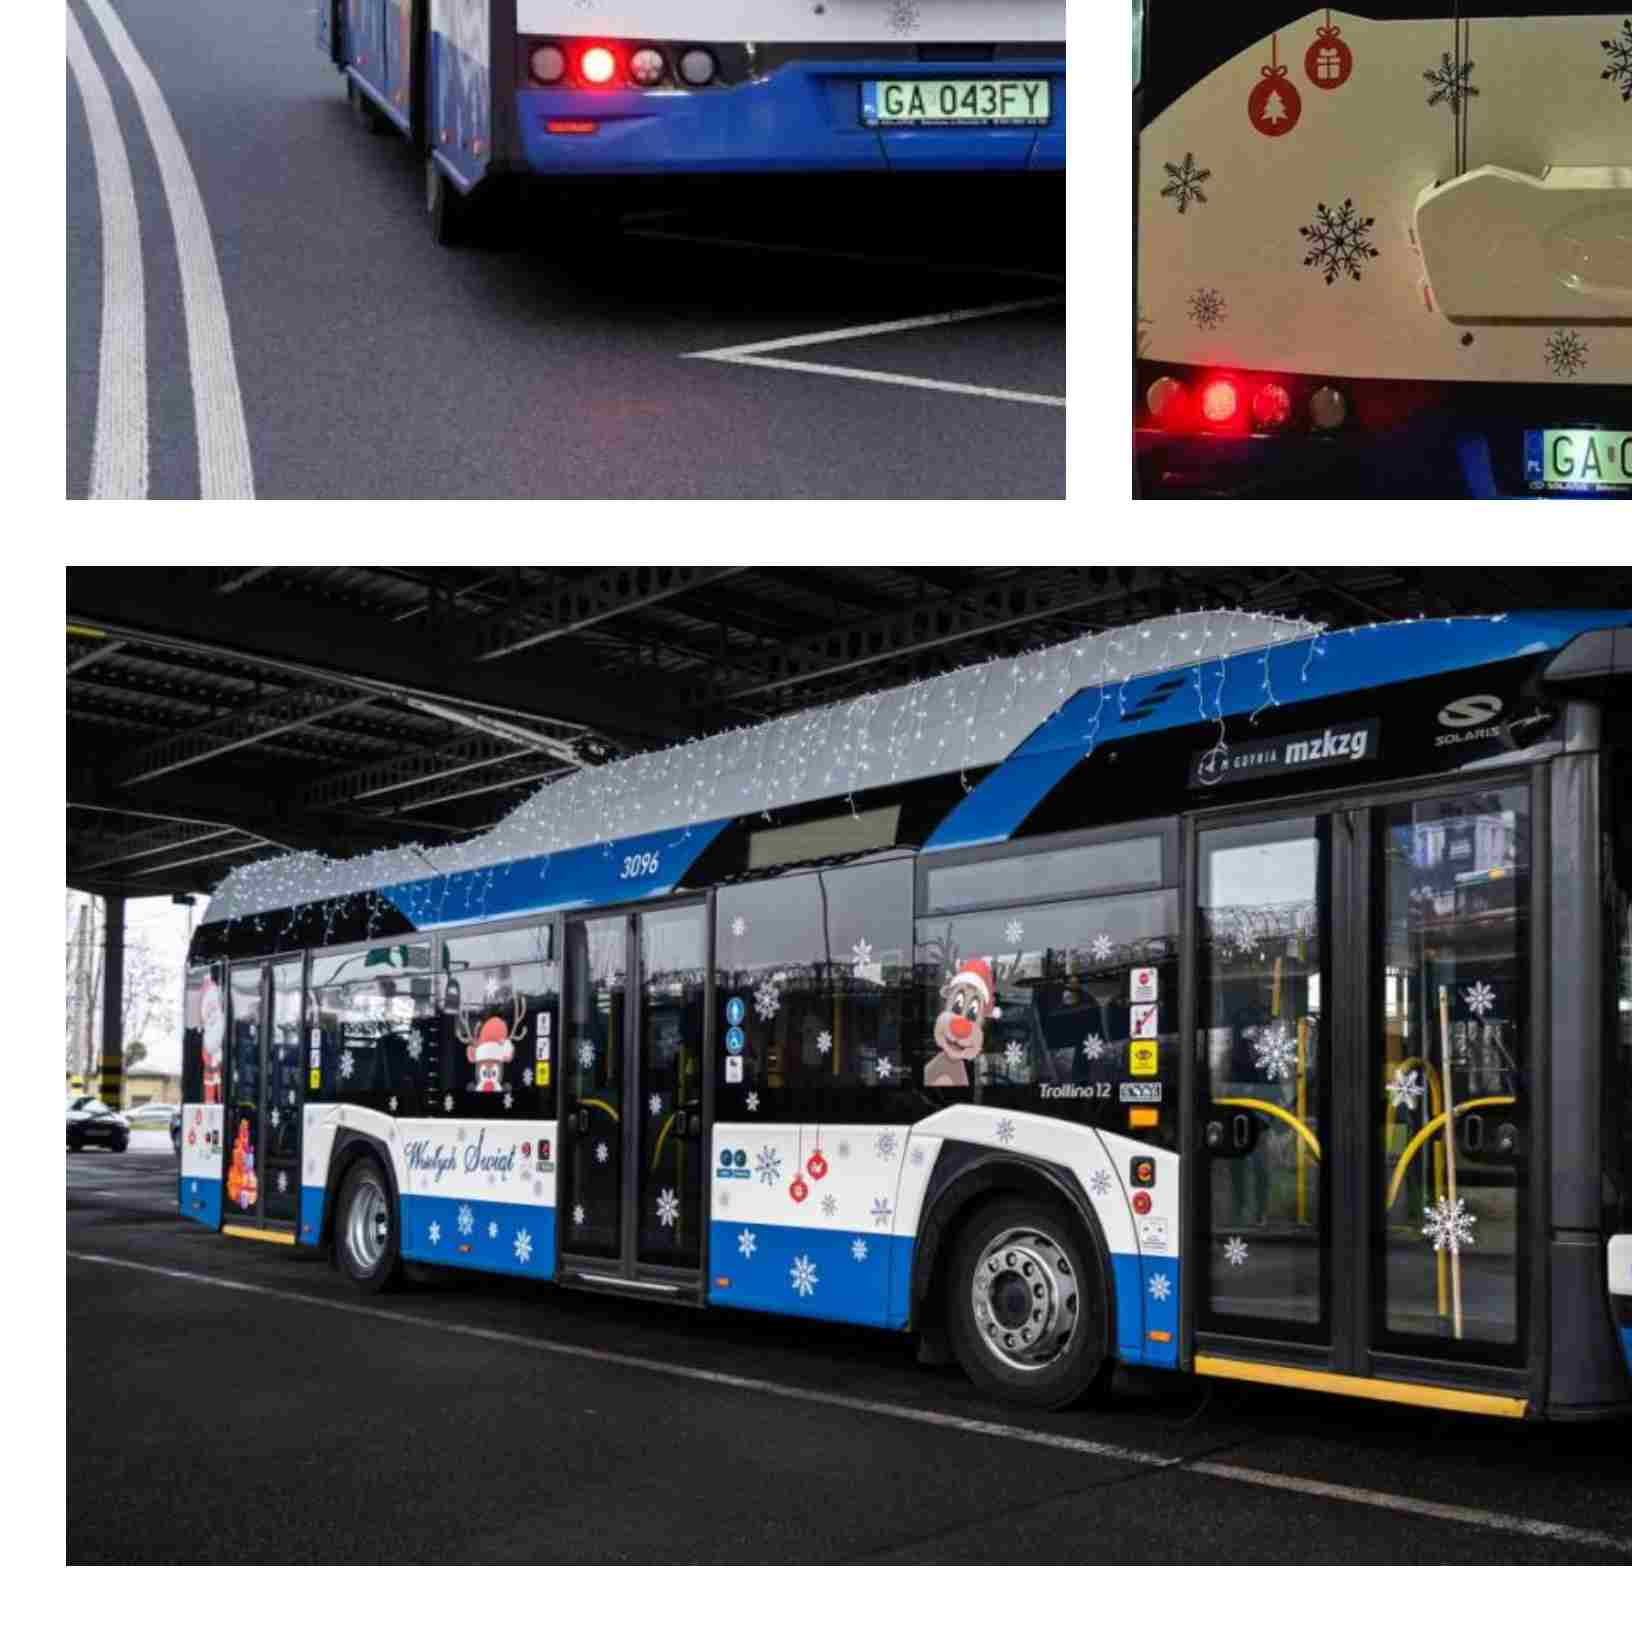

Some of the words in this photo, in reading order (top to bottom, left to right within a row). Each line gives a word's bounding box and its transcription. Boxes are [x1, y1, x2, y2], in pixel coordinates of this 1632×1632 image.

[884, 84, 926, 116] GA
[940, 83, 1040, 116] 043FY
[1552, 435, 1603, 478] GA
[1285, 730, 1369, 764] mzkzg
[1434, 726, 1500, 747] SOLARIS
[620, 850, 660, 879] 3096
[1096, 1081, 1112, 1098] 12
